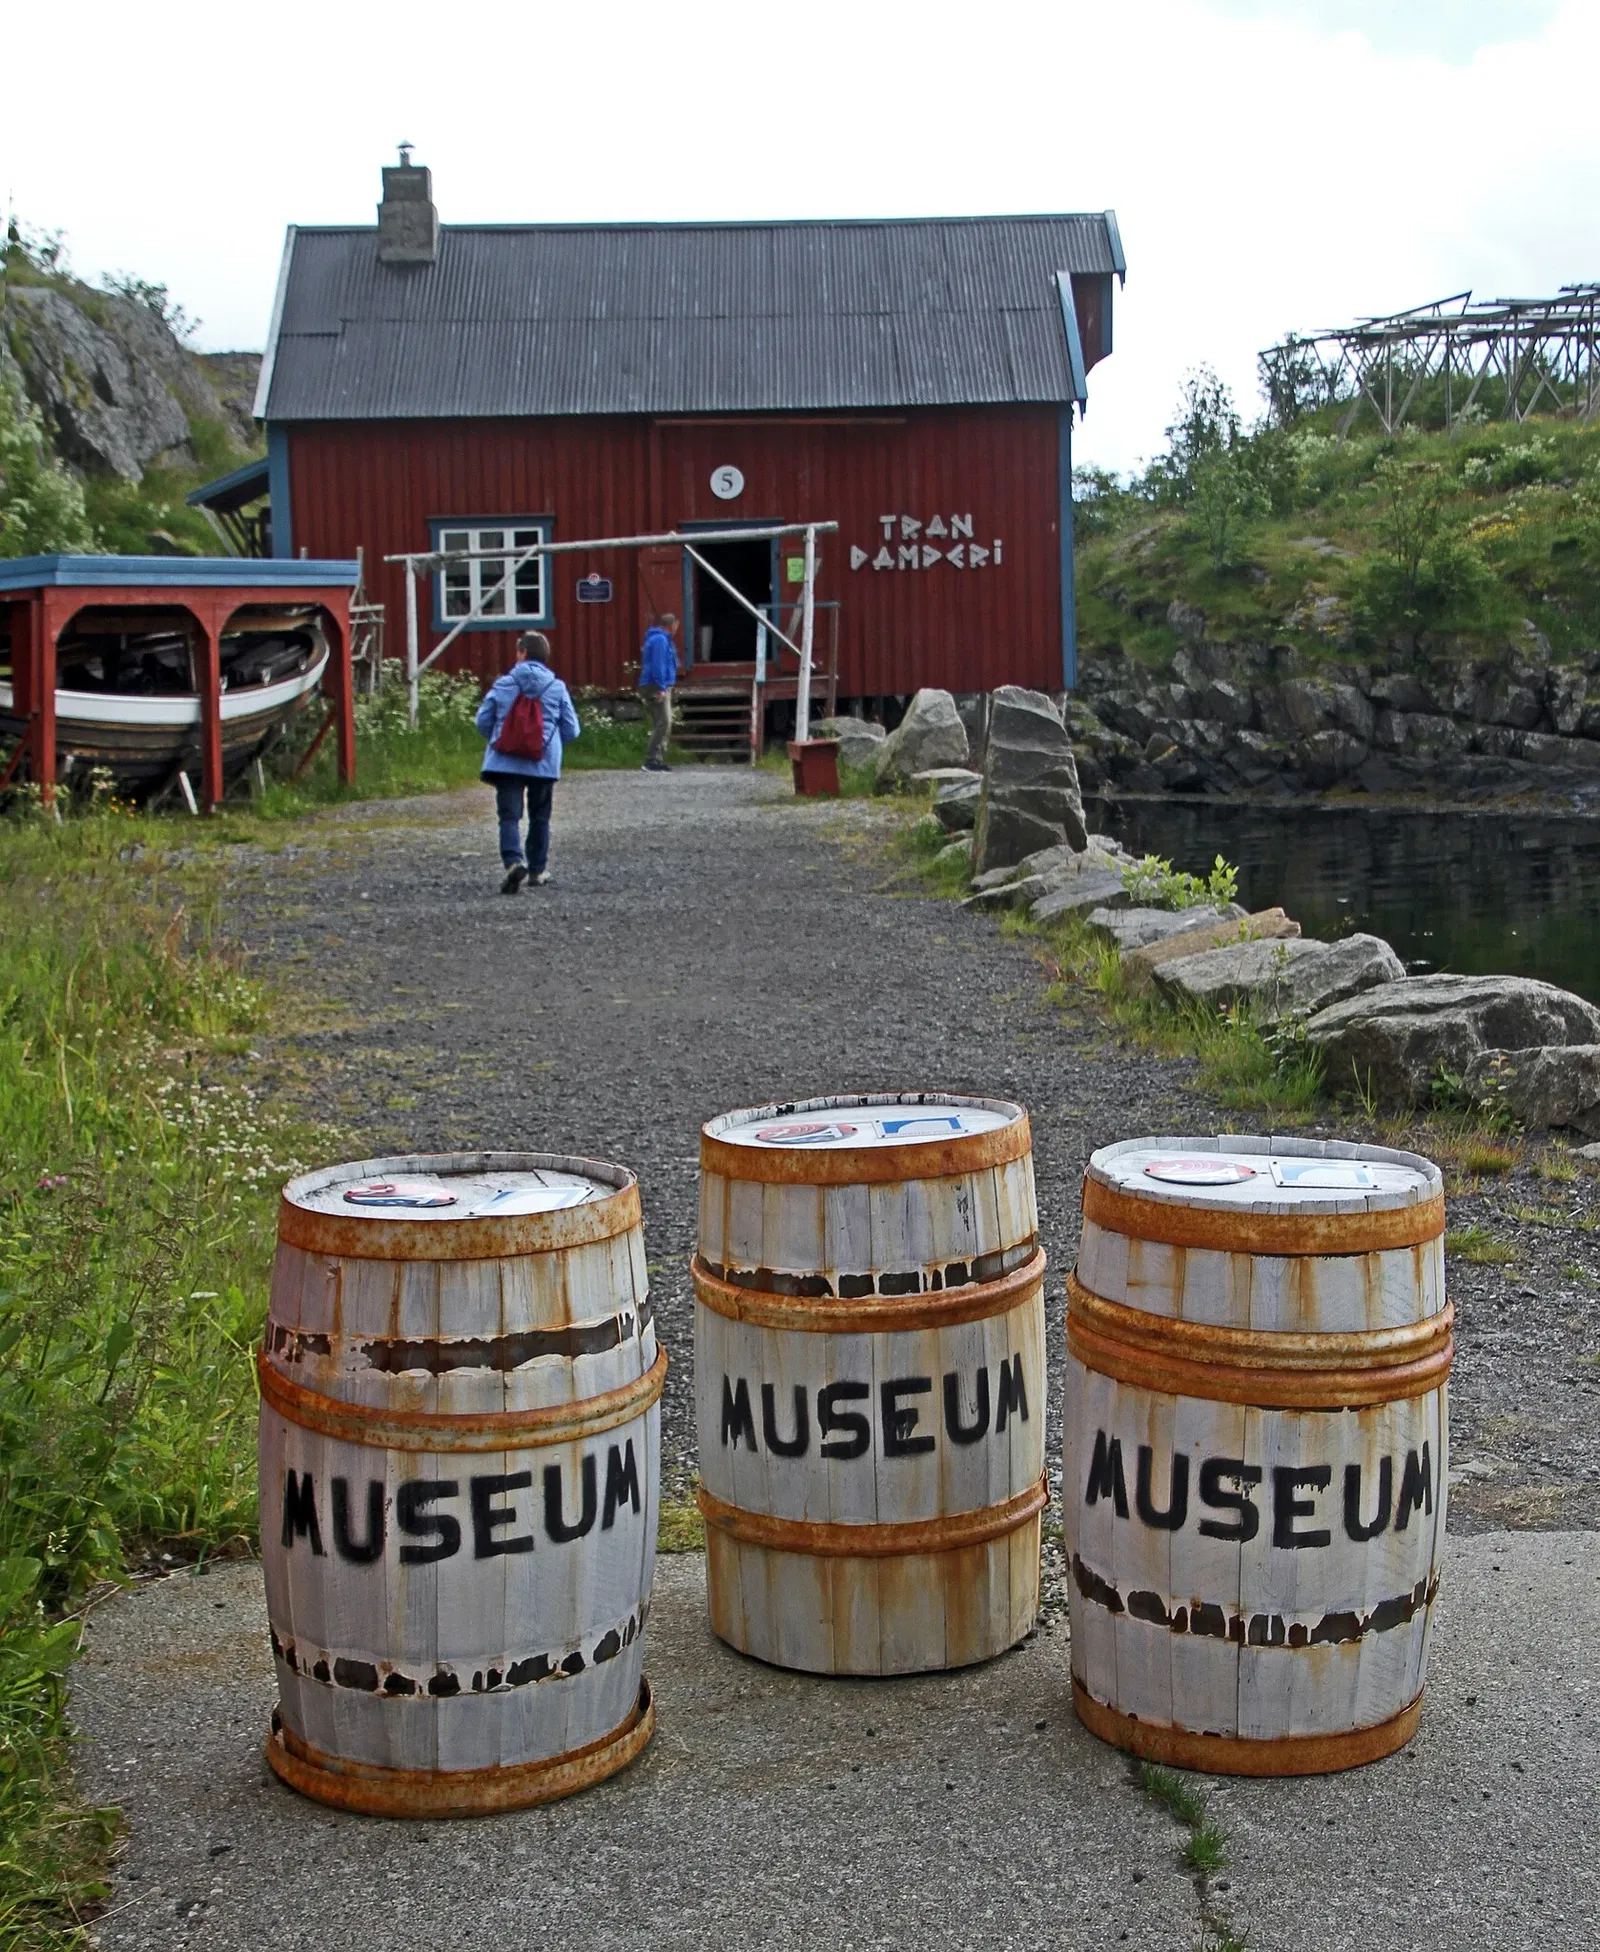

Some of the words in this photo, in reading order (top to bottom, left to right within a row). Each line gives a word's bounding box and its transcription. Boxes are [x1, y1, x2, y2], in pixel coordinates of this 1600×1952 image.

[721, 472, 733, 493] 5
[879, 513, 974, 540] TRAN
[720, 1352, 1030, 1460] MUSEUM
[280, 1437, 642, 1566] MUSEUM
[1085, 1428, 1433, 1550] MUSEUM
